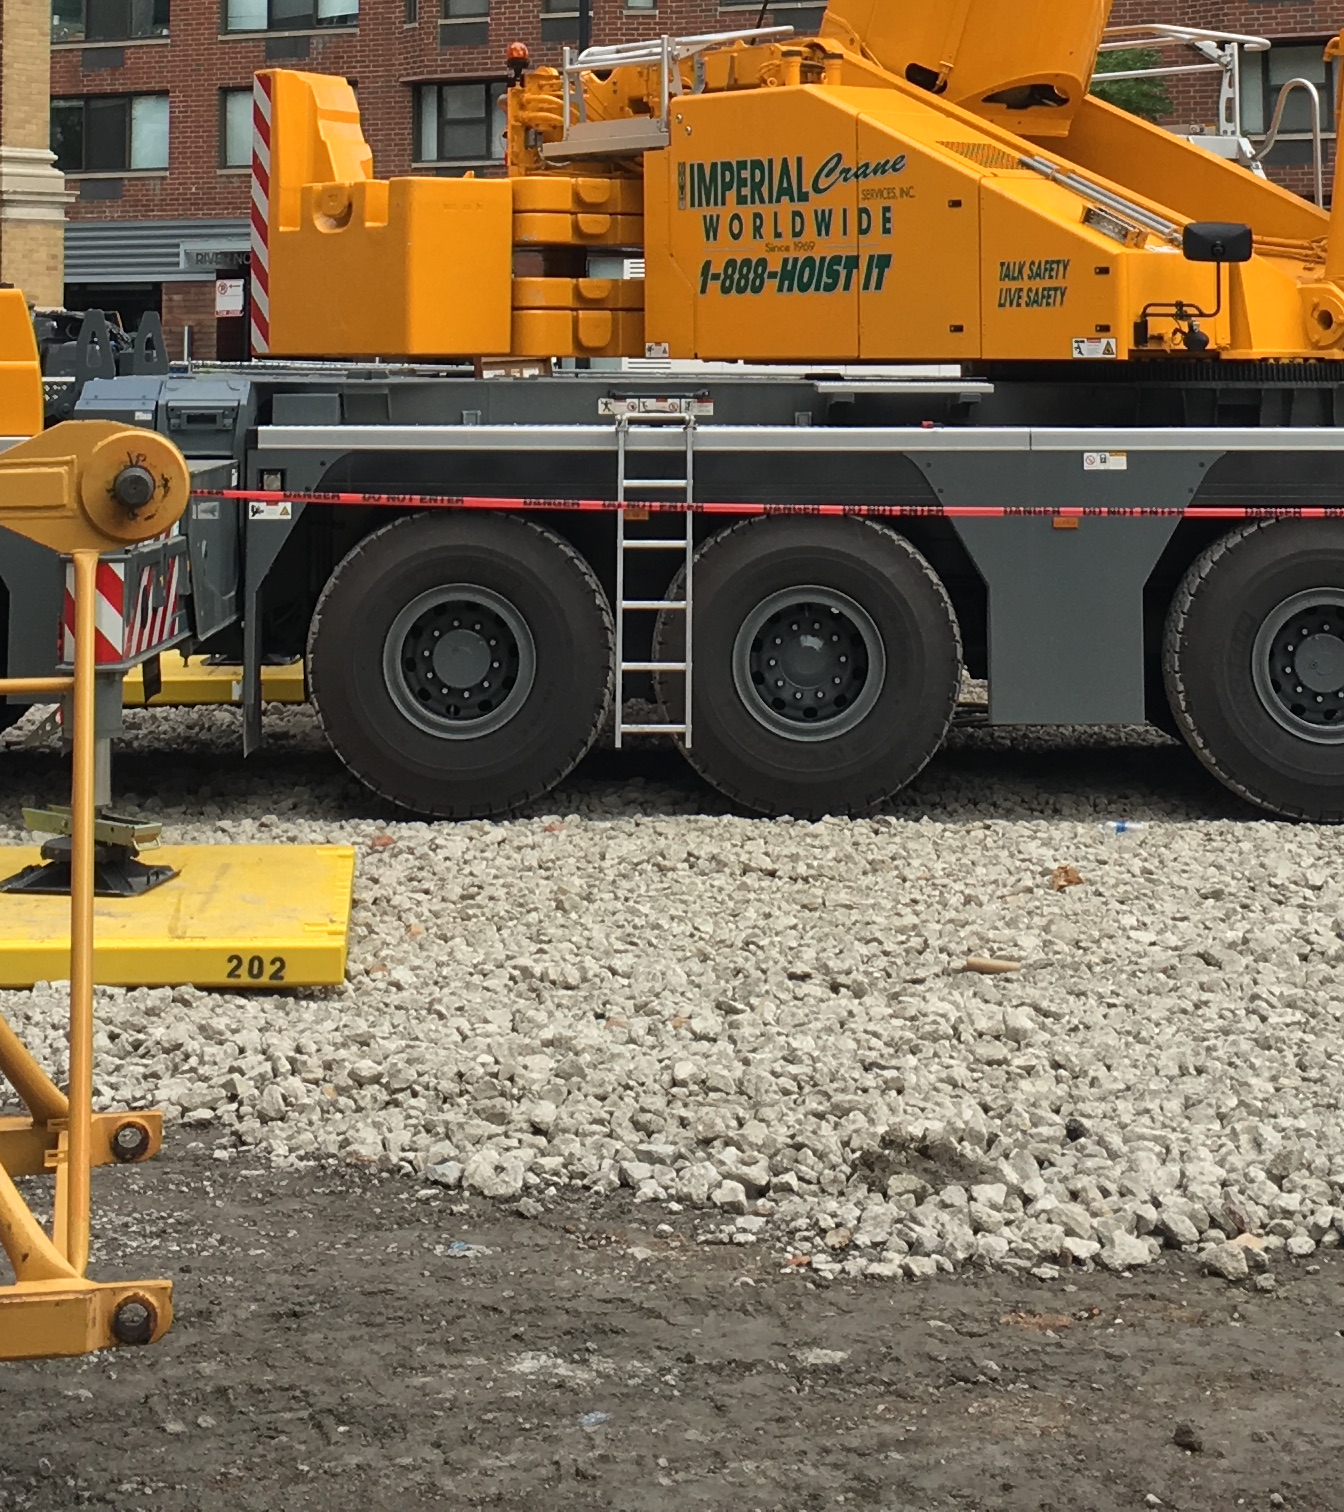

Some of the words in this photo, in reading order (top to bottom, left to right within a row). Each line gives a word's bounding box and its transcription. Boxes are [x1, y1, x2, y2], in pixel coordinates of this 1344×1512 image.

[689, 156, 810, 209] IMPERIAL
[811, 152, 906, 195] Crane
[702, 205, 893, 242] WORLDWIDE
[765, 243, 791, 254] Since
[793, 241, 816, 253] 1969
[699, 254, 860, 296] 1-888-HOIST
[861, 252, 893, 293] IT
[999, 260, 1027, 282] TALK
[1027, 258, 1071, 281] SAFETY
[997, 287, 1024, 308] LIVE
[1024, 286, 1068, 308] SAFETY
[226, 953, 287, 981] 202
